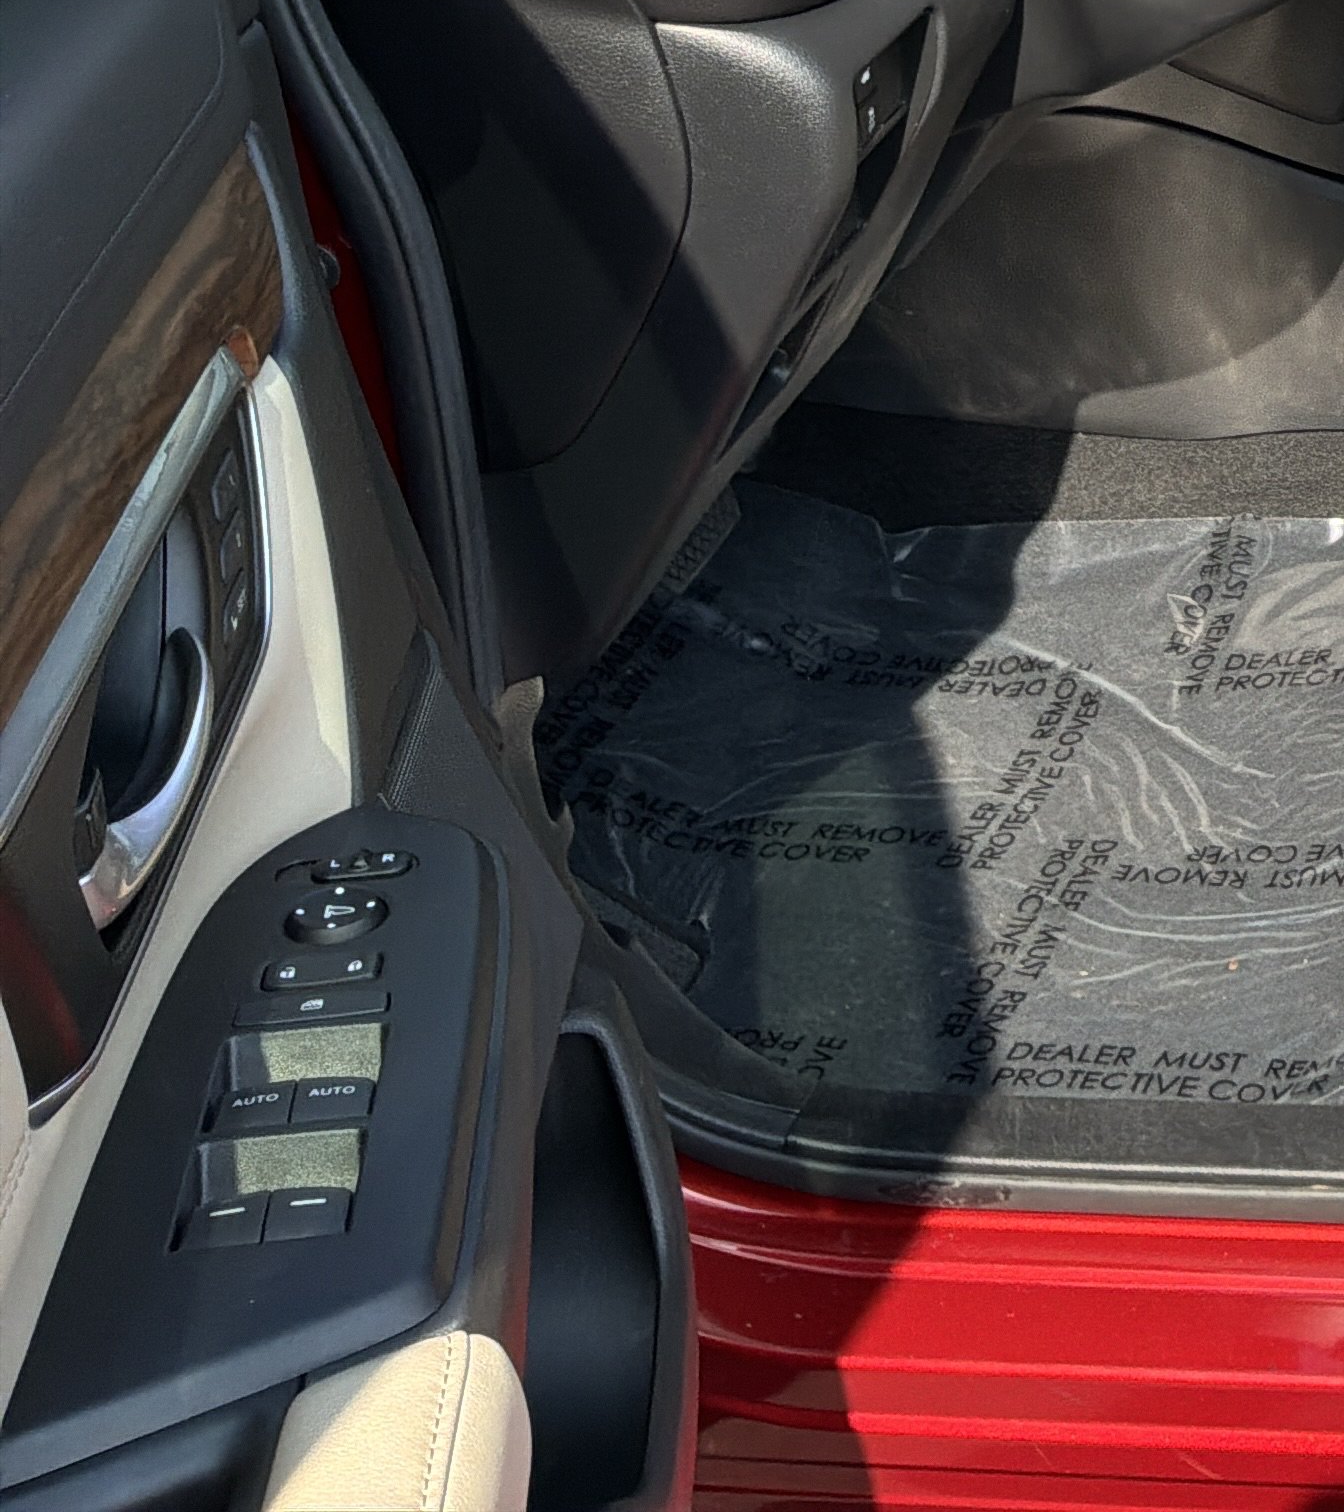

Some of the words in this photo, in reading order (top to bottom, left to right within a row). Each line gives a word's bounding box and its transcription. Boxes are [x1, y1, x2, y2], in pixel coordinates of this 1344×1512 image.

[1220, 534, 1258, 602] MUST
[1177, 612, 1236, 696] REMOVE
[1223, 646, 1334, 673] DEALER
[937, 676, 1048, 698] DEALER
[969, 765, 1064, 870] PROTECTIVE
[1049, 686, 1103, 763] COVER
[571, 791, 753, 858] PROTECTIVE
[756, 842, 872, 863] COVER
[936, 801, 1004, 869] DEALER
[992, 748, 1042, 795] MUST
[711, 816, 801, 838] MUST
[810, 823, 952, 847] REMOVE
[1185, 837, 1298, 864] COVER
[329, 859, 341, 868] L
[381, 853, 396, 863] R
[1059, 838, 1118, 912] DEALER
[1112, 862, 1246, 889] REMOVE
[989, 838, 1085, 955] PROTECTIVE
[1015, 922, 1066, 980] MUST
[935, 960, 1005, 1039] COVER
[946, 989, 1028, 1086] REMOVE
[1006, 1041, 1136, 1068] DEALER
[1154, 1049, 1248, 1074] MUST
[231, 1093, 280, 1108] AUTO
[308, 1085, 356, 1098] AUTO
[991, 1067, 1200, 1099] PROTECTIVE
